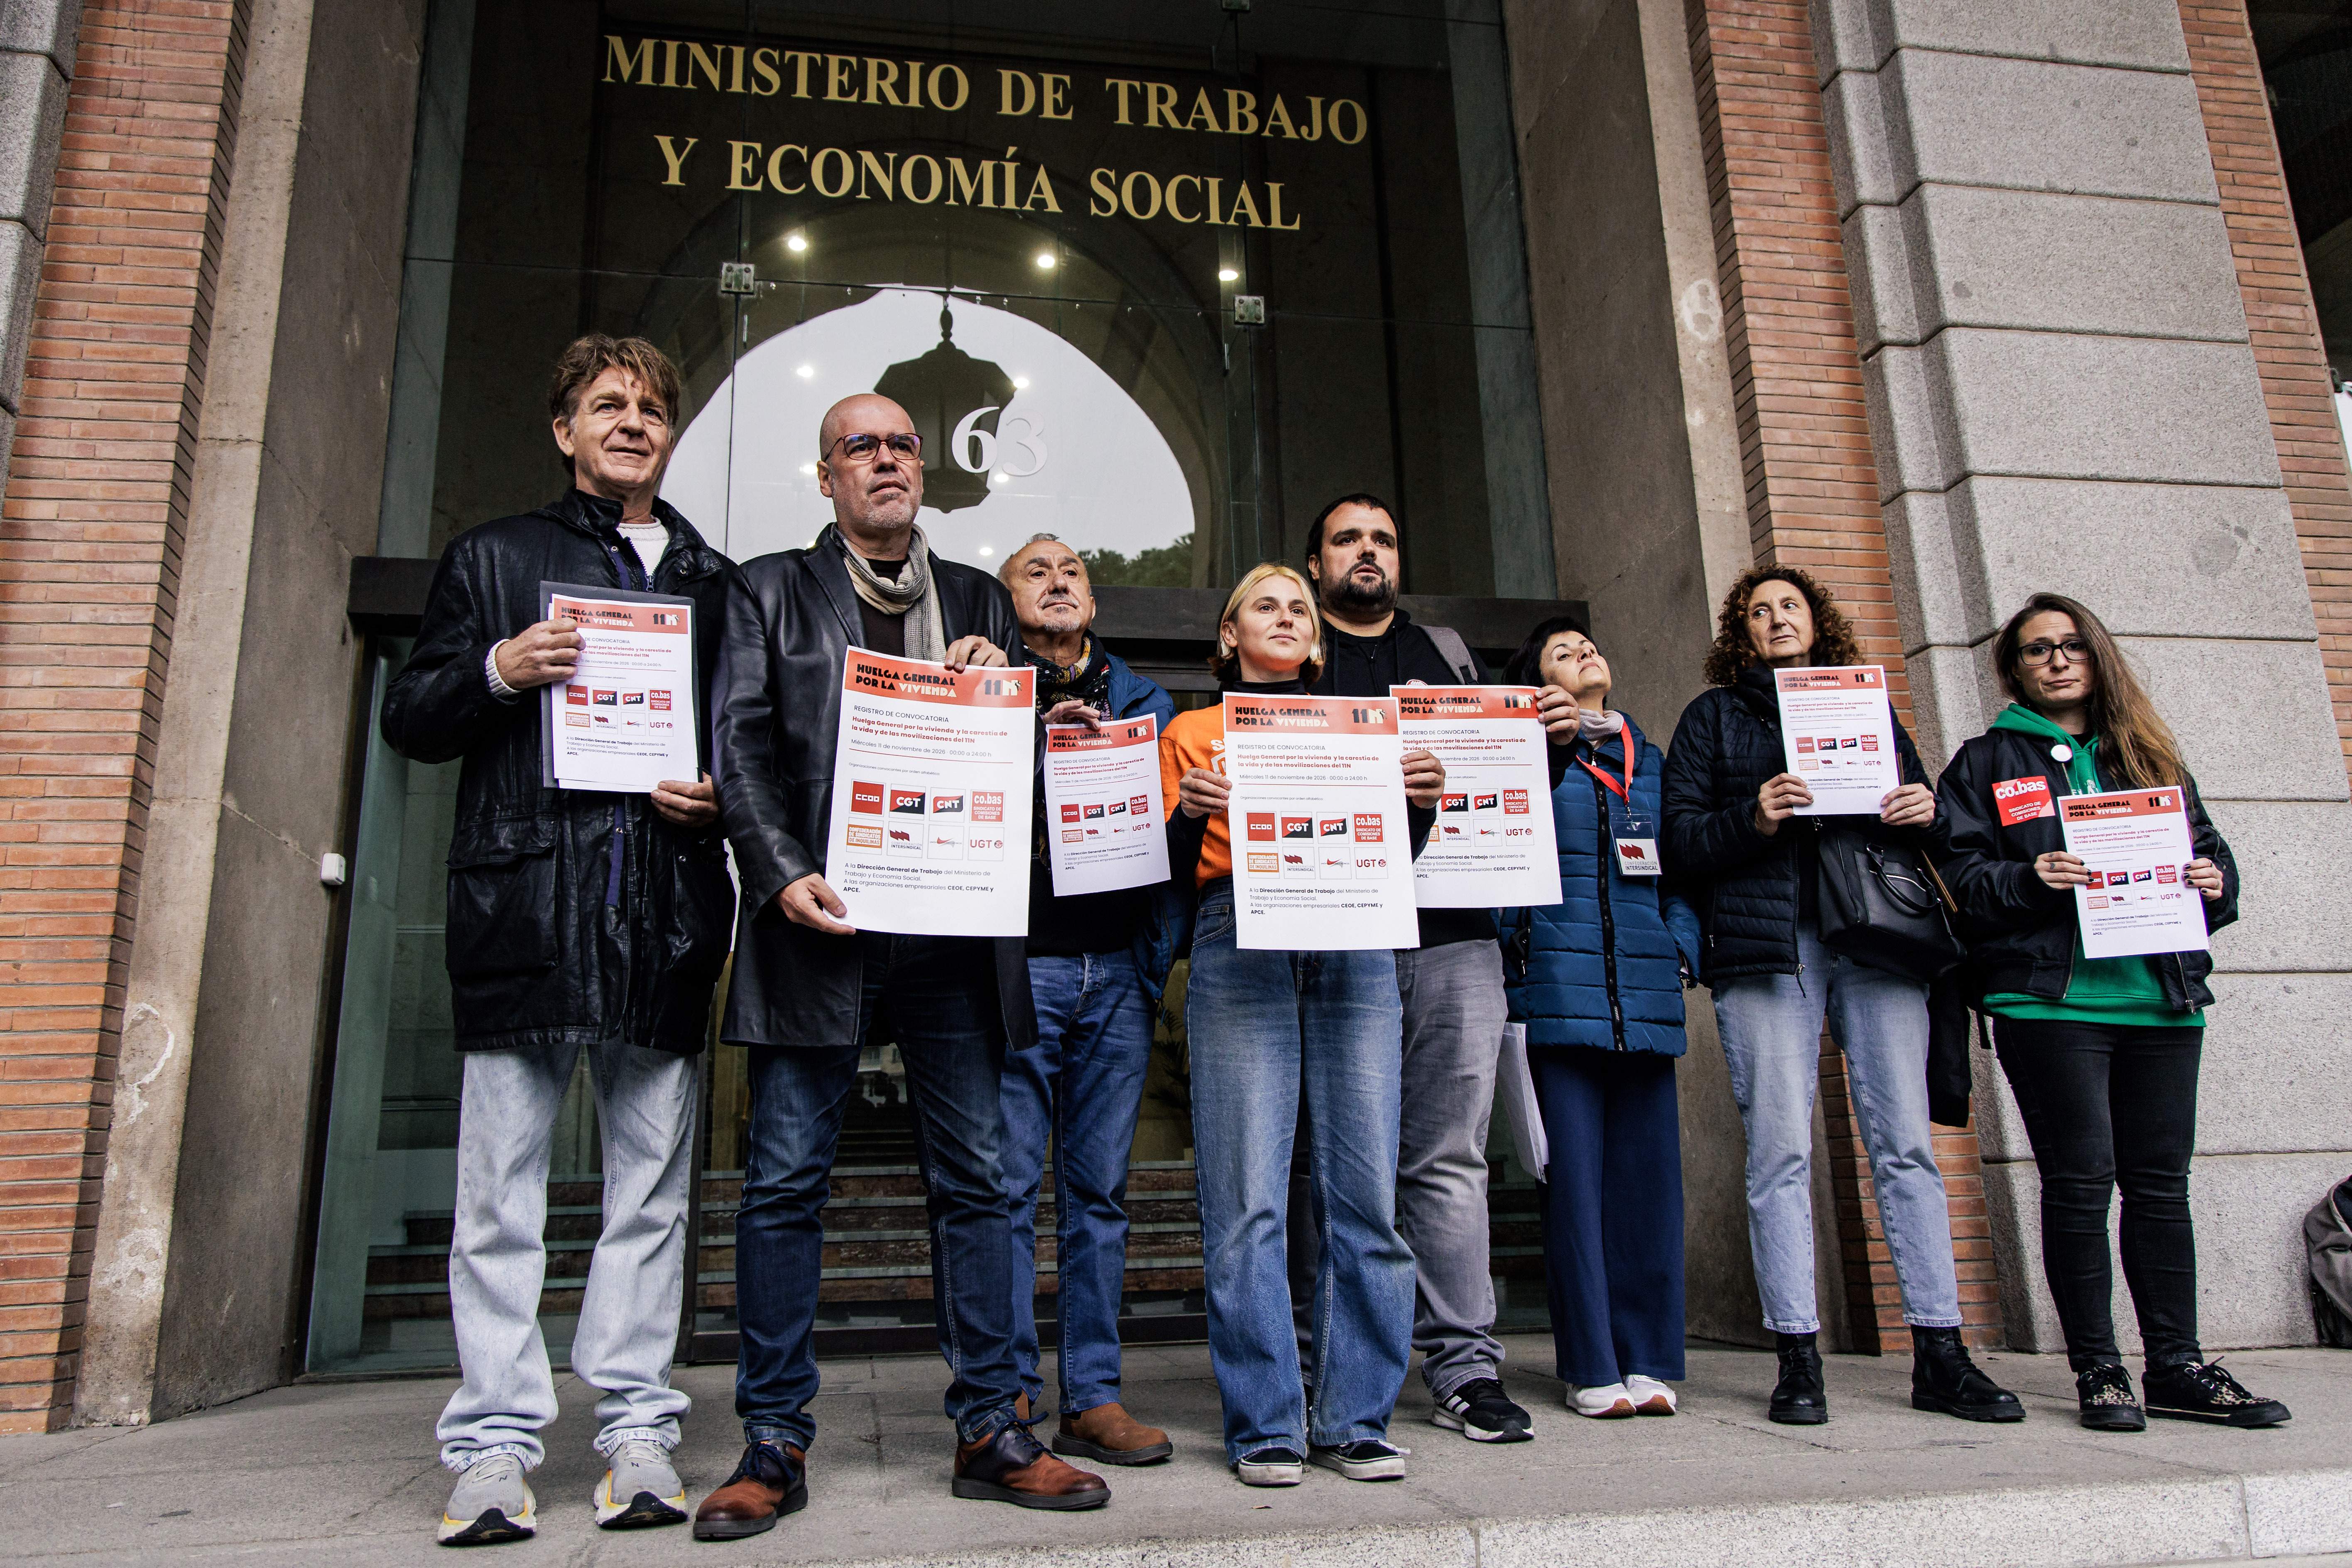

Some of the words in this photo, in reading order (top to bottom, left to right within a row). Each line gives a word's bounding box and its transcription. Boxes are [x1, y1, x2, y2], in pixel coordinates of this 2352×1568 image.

[601, 34, 969, 111] MINISTERIO
[996, 69, 1073, 120] DE
[1105, 78, 1367, 145] TRABAJO
[653, 134, 698, 186] Y
[725, 140, 1063, 213] ECONOMÍA
[1090, 167, 1301, 230] SOCIAL
[951, 406, 1048, 477] 63
[561, 607, 593, 616] HUELGA
[593, 617, 635, 627] VIVIENDA
[857, 664, 900, 680] HUELGA
[903, 672, 956, 686] GENERAL
[856, 675, 878, 687] POR
[881, 680, 896, 690] LA
[899, 683, 957, 698] VIVIENDA
[854, 705, 884, 715] REGISTRO
[895, 712, 948, 722] CONVOCATORIA
[1235, 707, 1276, 715] HUELGA
[853, 716, 875, 725] Huelga
[1276, 718, 1329, 727] VIVIENDA
[900, 733, 951, 741] movilizaciones
[851, 739, 877, 747] Miércoles
[1996, 781, 2046, 799] co.bas
[974, 793, 1002, 804] co.bas
[1505, 790, 1527, 800] co.bas
[896, 796, 921, 807] CGT
[936, 800, 960, 809] CNT
[1131, 796, 1147, 805] co.bas
[1446, 798, 1465, 806] CGT
[1477, 797, 1494, 806] CNT
[2008, 803, 2034, 813] SINDICATO
[2011, 806, 2041, 817] COMISIONES
[2096, 807, 2133, 815] VIVIENDA
[1356, 815, 1381, 826] co.bas
[1287, 823, 1309, 832] CGT
[1323, 823, 1343, 832] CNT
[970, 840, 992, 848] UGT
[1356, 859, 1376, 867] UGT
